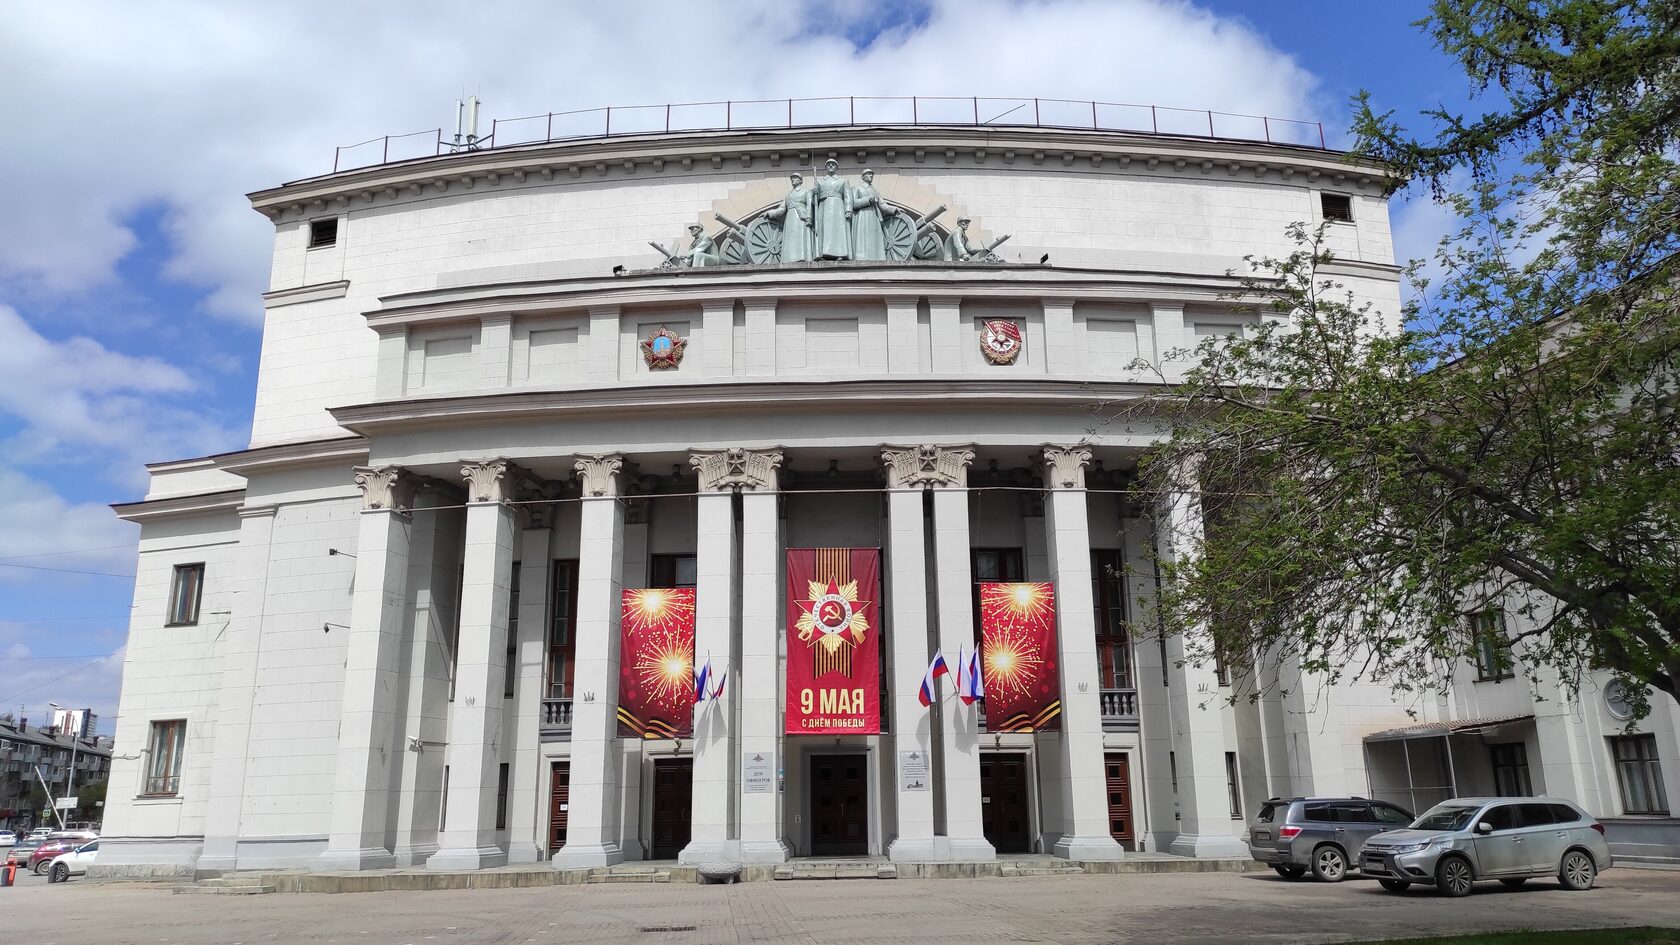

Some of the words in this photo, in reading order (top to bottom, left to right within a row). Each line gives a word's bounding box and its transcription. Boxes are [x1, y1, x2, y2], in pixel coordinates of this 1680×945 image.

[801, 688, 814, 714] 9
[820, 688, 865, 714] МАЯ
[801, 718, 807, 728] С
[808, 717, 831, 729] ДНЁМ
[832, 718, 865, 729] ПОБЕДЫ
